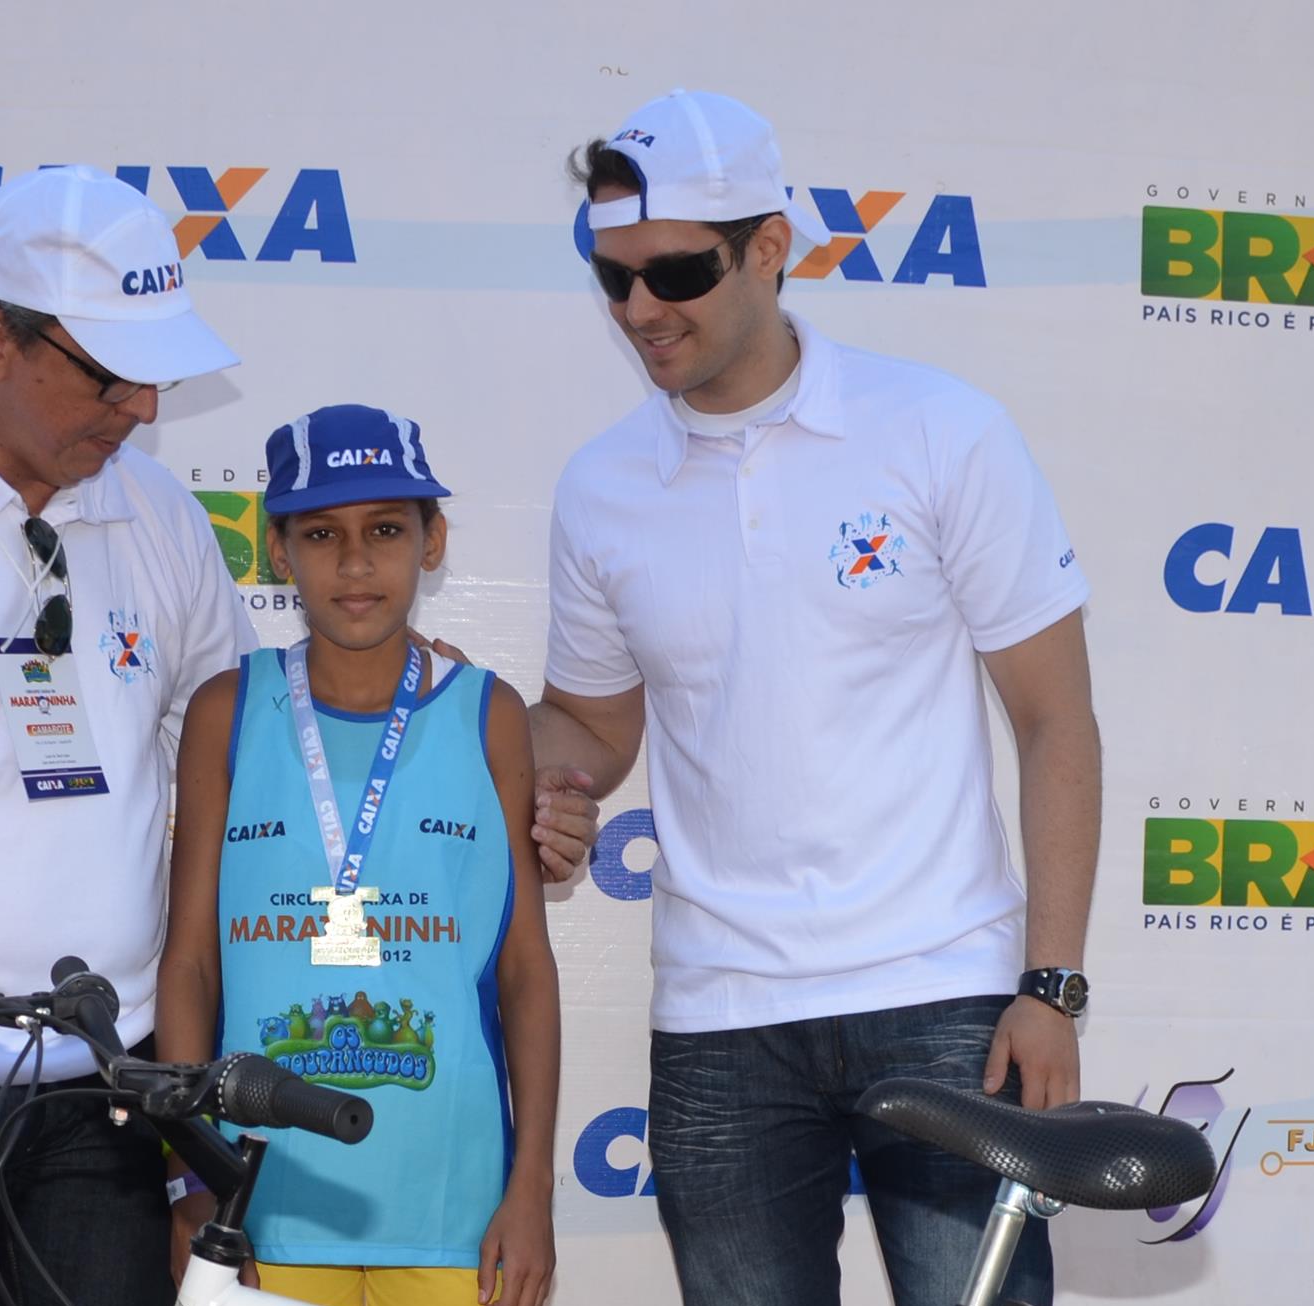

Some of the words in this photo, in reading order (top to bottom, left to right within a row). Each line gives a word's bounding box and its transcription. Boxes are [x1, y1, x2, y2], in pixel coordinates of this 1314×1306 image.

[1143, 303, 1197, 324] PAÍS
[1210, 308, 1270, 329] RICO
[1283, 311, 1296, 330] É
[327, 448, 393, 468] CAIXA
[381, 706, 410, 761] CAIXA
[358, 778, 387, 835] CAIXA
[227, 820, 286, 843] CAIXA
[419, 818, 477, 842] CAIXA
[408, 892, 429, 905] DE
[1143, 913, 1197, 930] PAÍS
[1209, 914, 1268, 931] RICO
[1281, 914, 1293, 932] É
[379, 950, 412, 963] 012
[329, 1023, 362, 1050] OS
